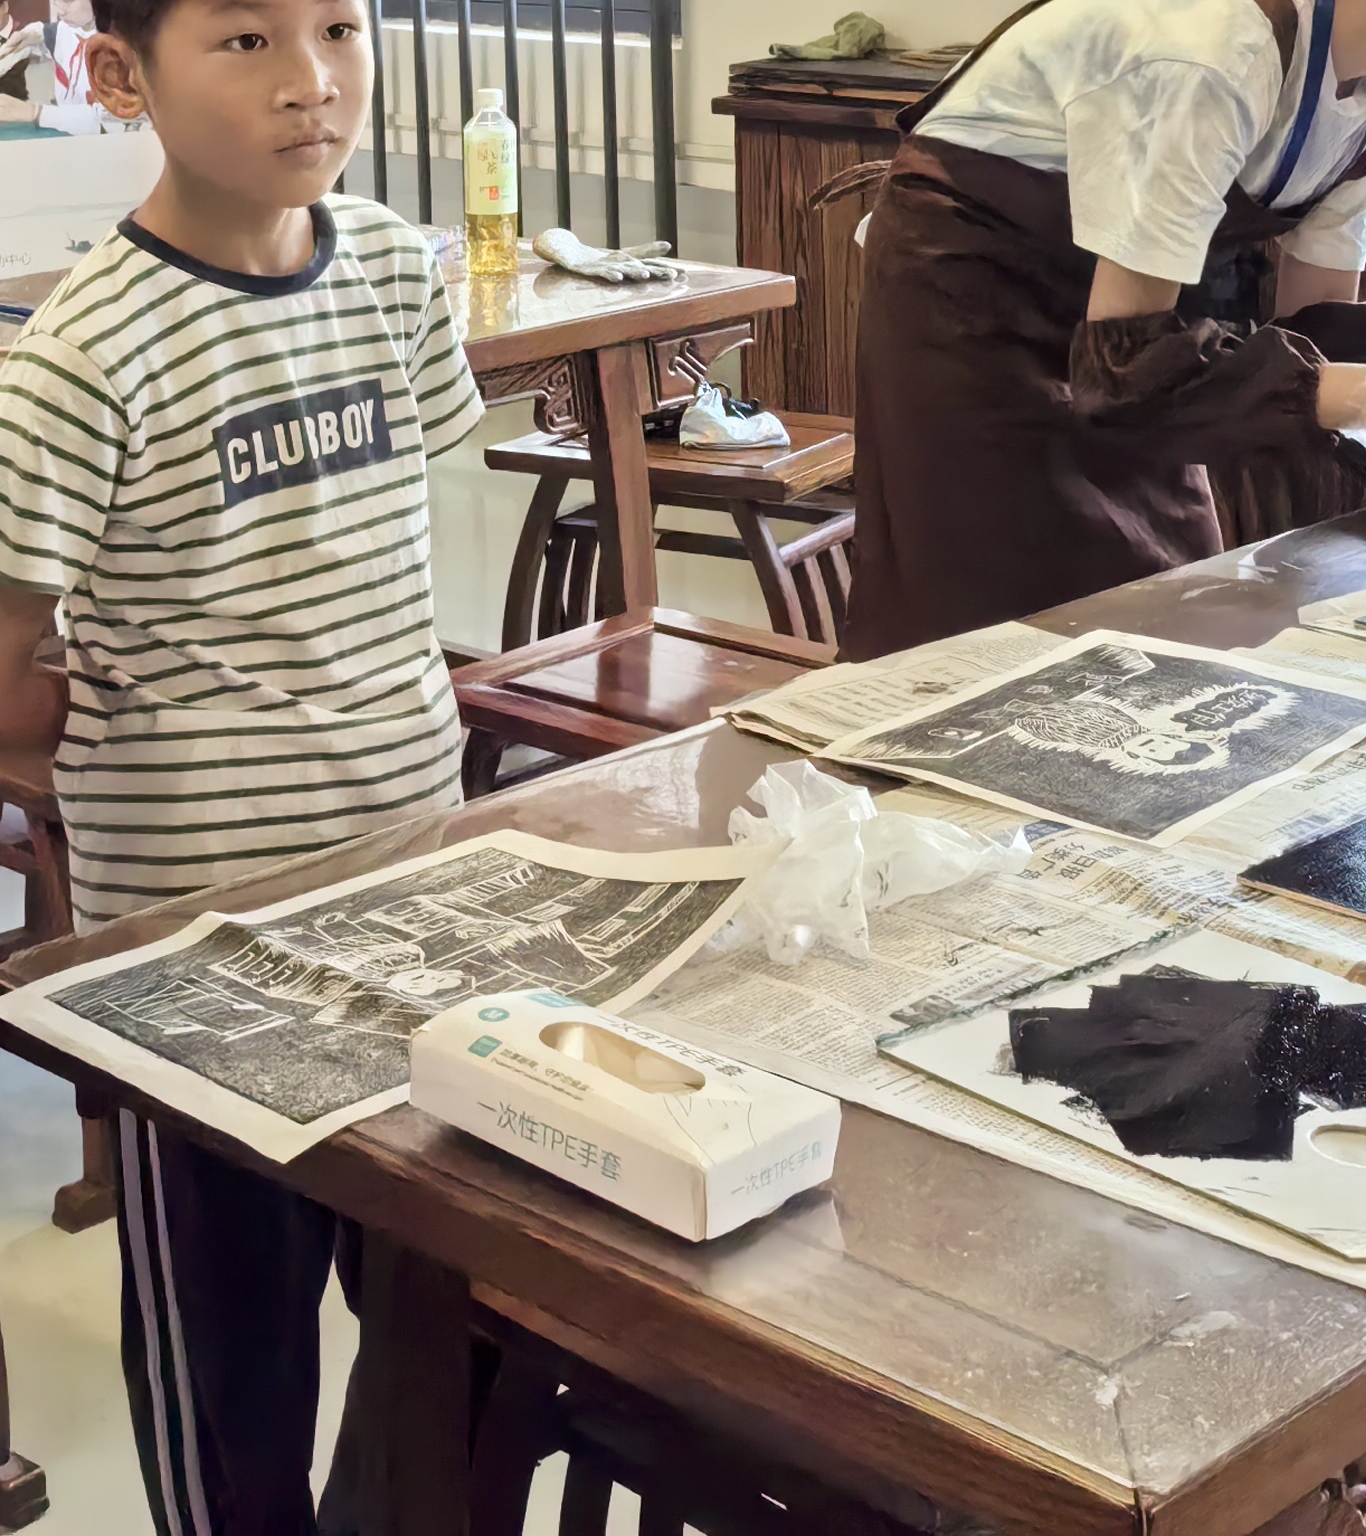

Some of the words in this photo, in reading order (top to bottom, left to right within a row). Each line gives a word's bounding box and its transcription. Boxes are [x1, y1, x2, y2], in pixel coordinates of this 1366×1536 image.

[477, 1100, 622, 1182] 一次性TPE手套
